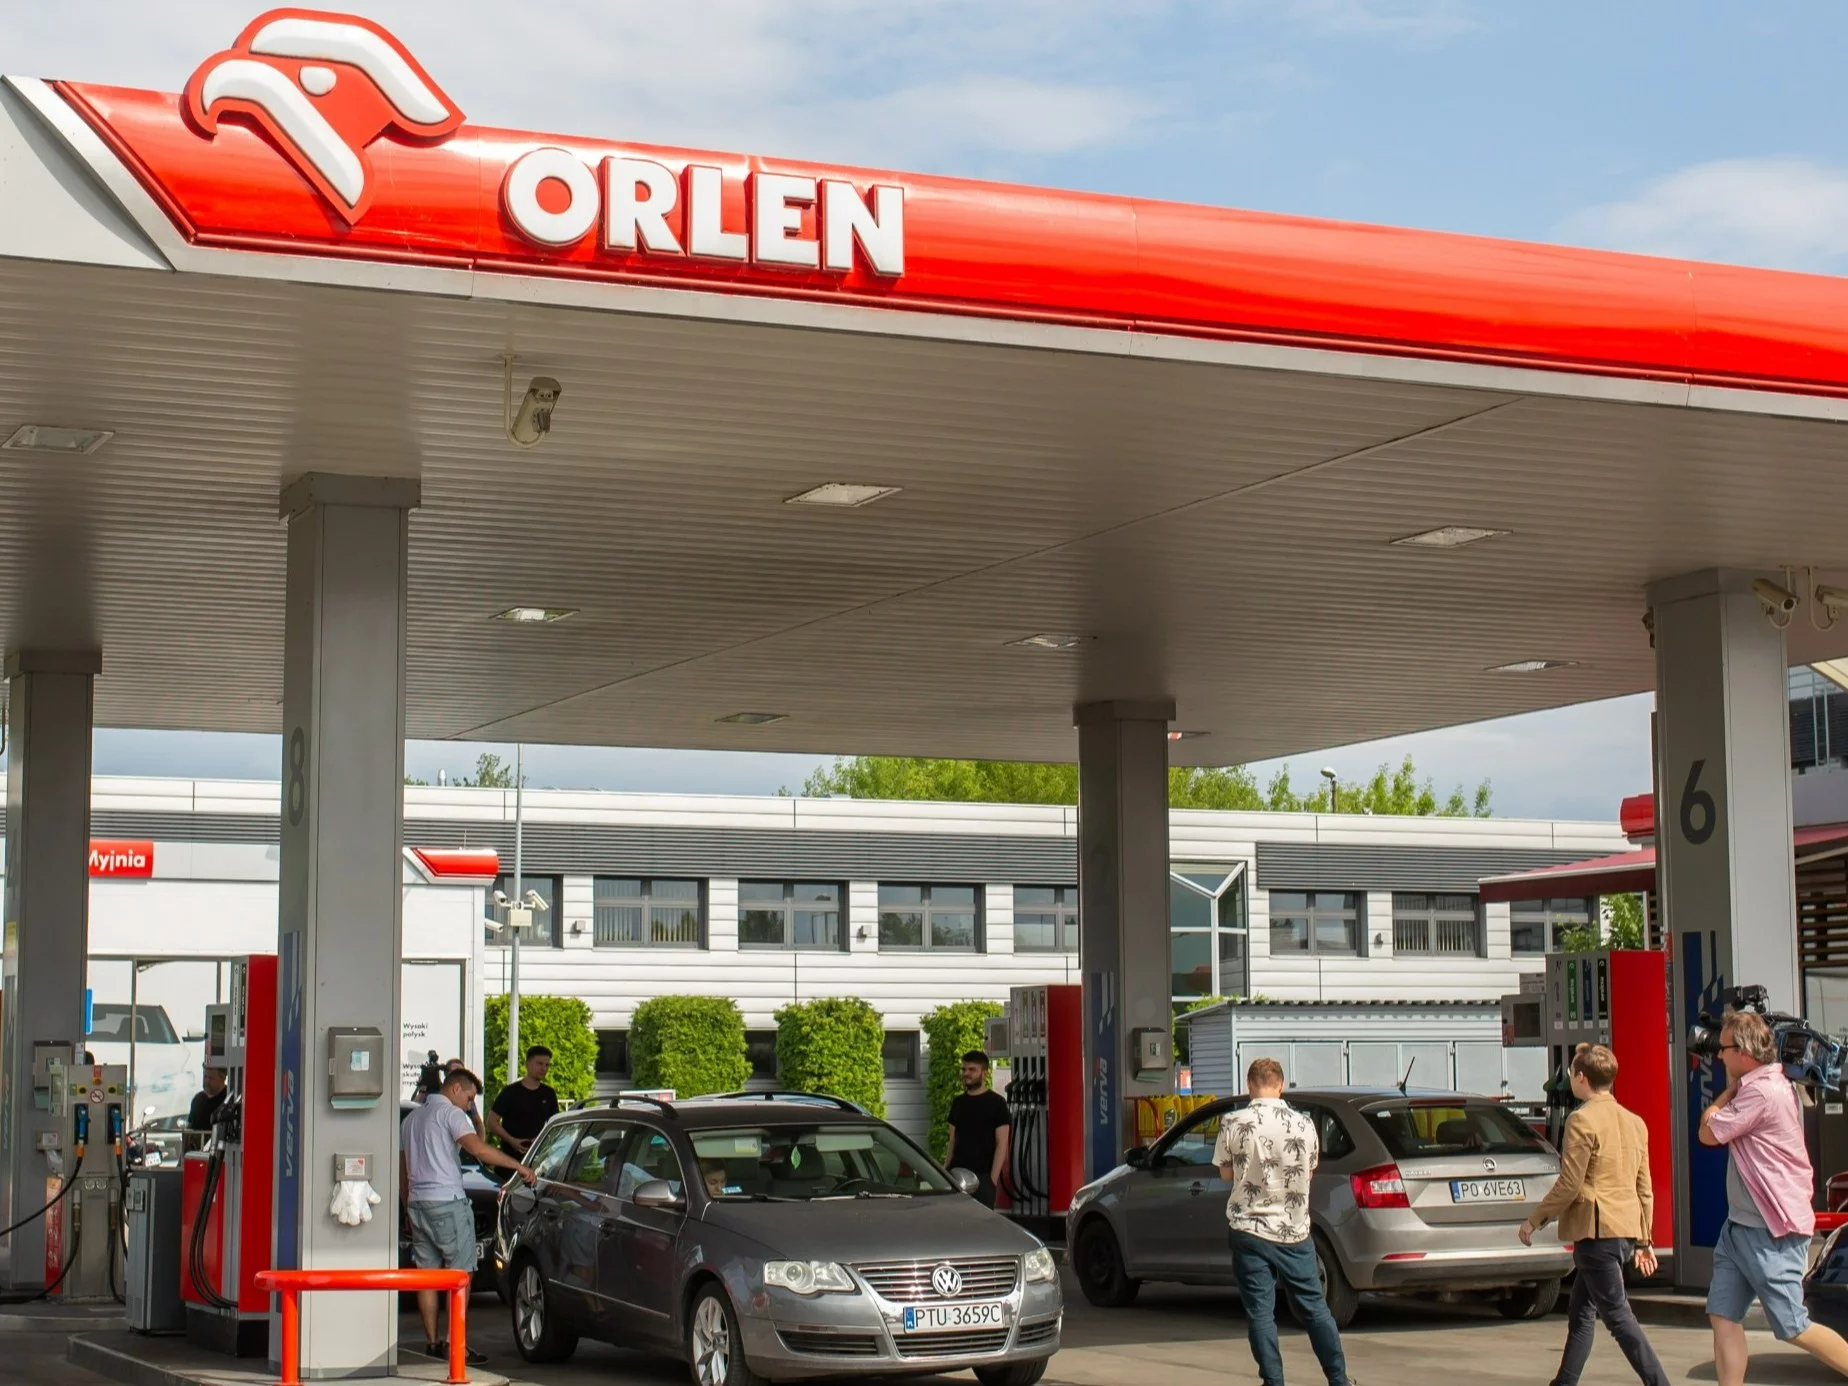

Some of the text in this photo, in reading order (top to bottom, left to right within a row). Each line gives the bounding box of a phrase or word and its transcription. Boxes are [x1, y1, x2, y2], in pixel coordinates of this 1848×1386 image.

[499, 147, 905, 276] ORLEN
[288, 726, 305, 826] 8
[1680, 759, 1716, 844] 6
[286, 1069, 294, 1177] verva
[1100, 1056, 1109, 1125] verva
[1461, 1181, 1520, 1198] PO 6VE63
[915, 1304, 1000, 1328] PTU 3659C
